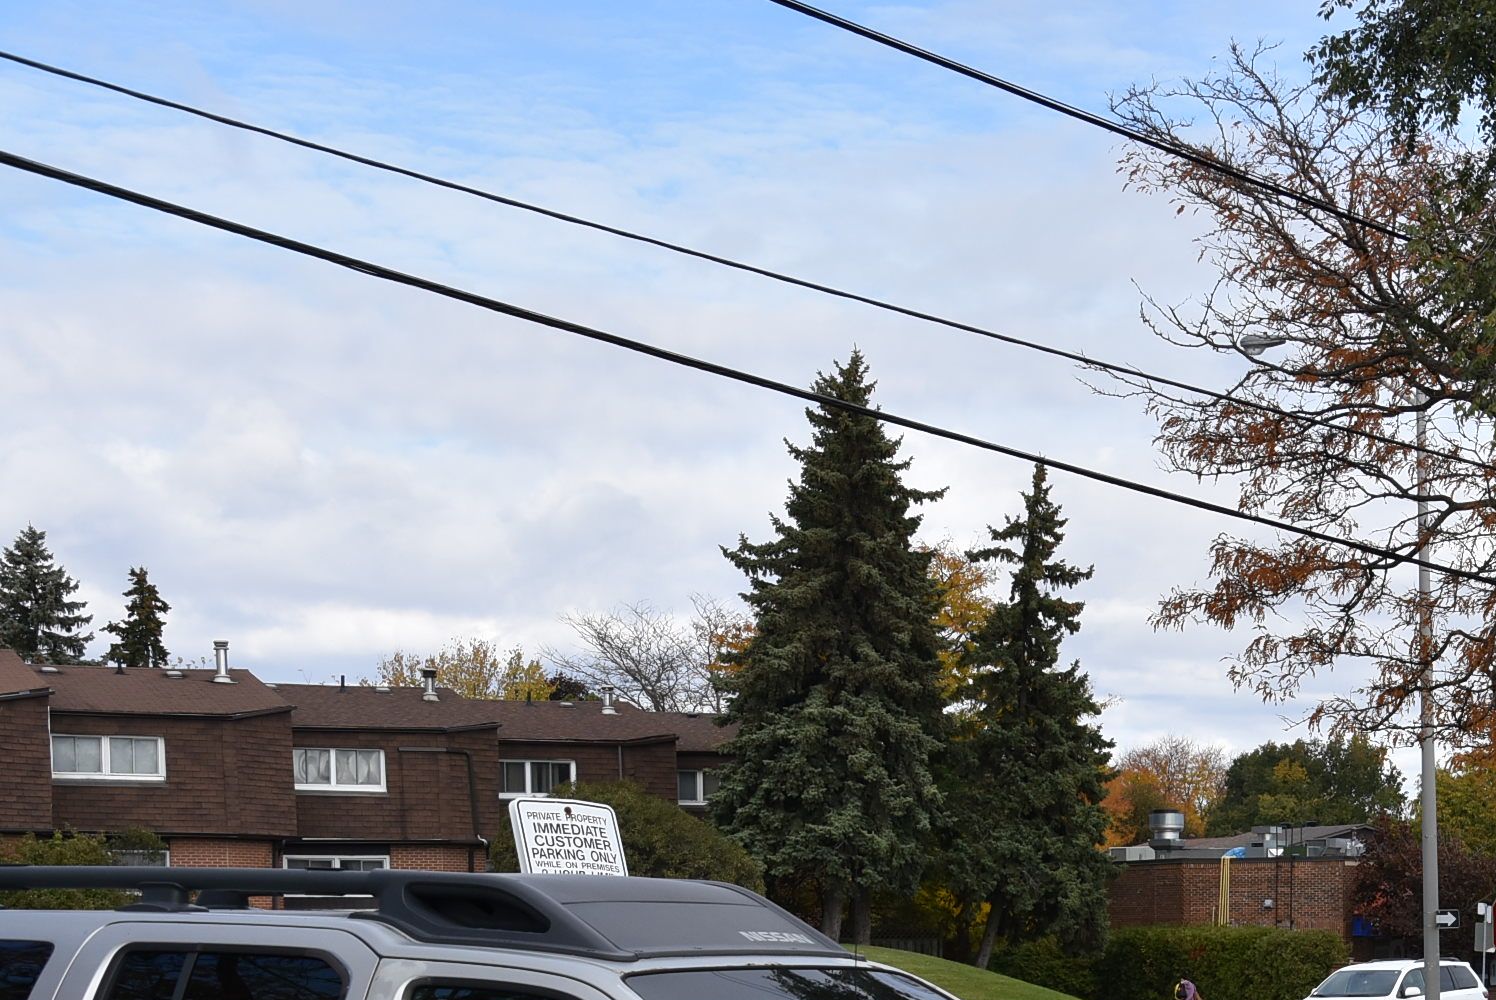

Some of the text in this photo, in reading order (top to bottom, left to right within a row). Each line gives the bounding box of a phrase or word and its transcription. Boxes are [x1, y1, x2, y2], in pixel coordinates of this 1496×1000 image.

[527, 811, 607, 826] PRIVATE PROPERTY
[533, 822, 607, 838] IMMEDIATE
[534, 835, 612, 851] CUSTOMER
[531, 847, 617, 864] PARKING ONLY
[581, 863, 620, 873] PREMISES
[739, 931, 815, 944] NISSAN
